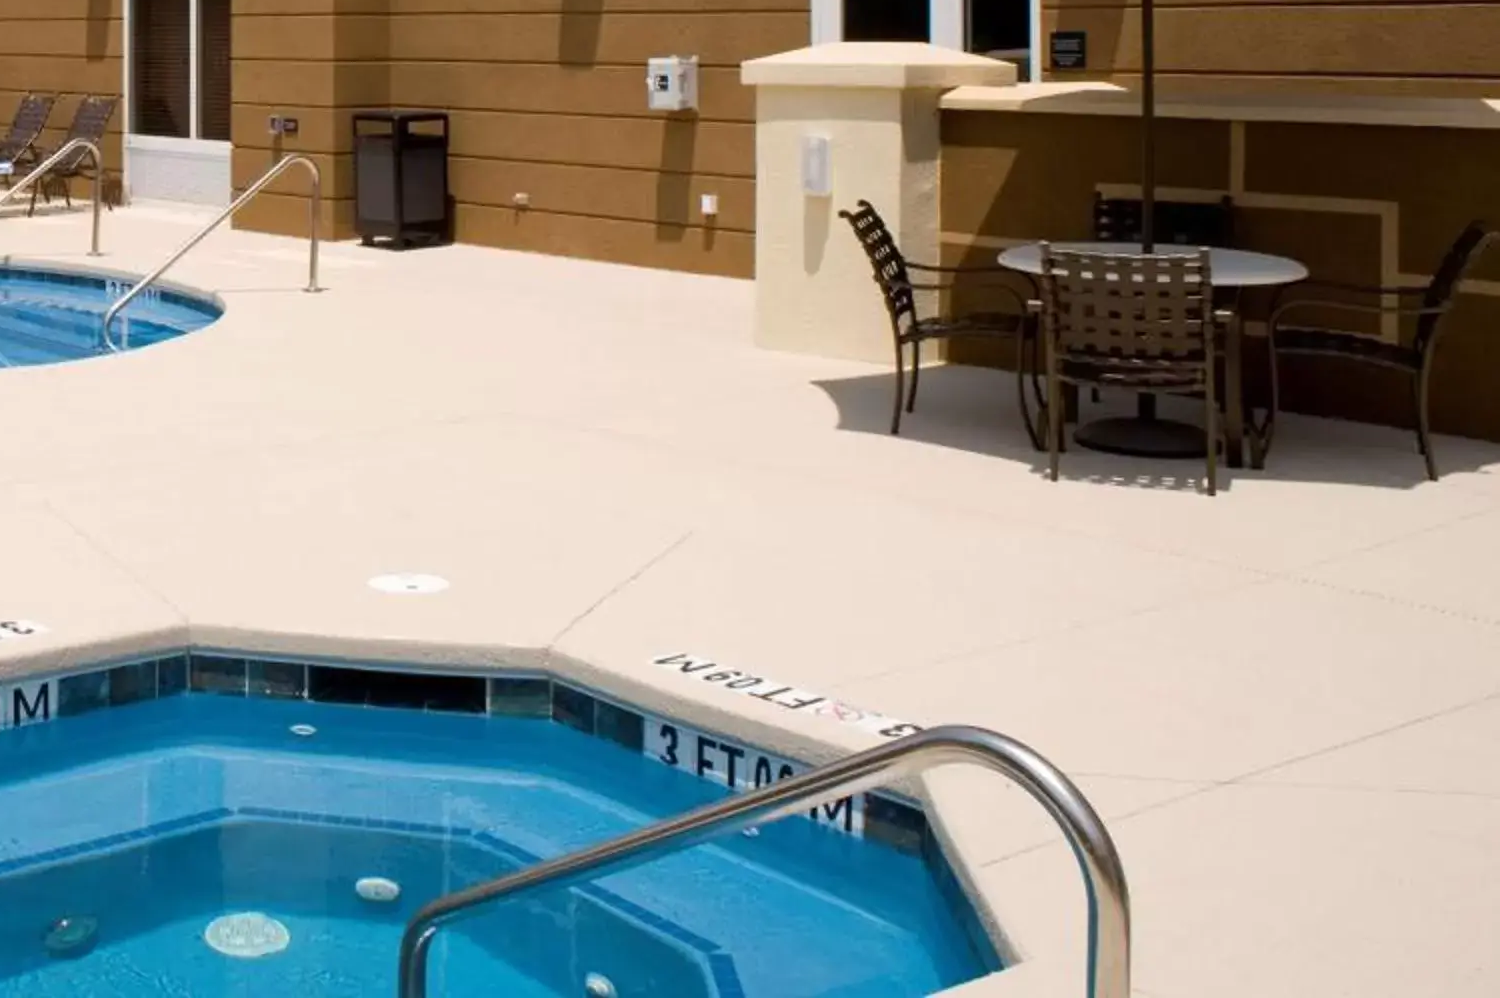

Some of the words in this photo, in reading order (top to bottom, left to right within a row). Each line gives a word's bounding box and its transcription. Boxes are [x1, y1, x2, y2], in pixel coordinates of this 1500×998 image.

[0, 620, 34, 636] 3
[654, 653, 717, 673] M
[13, 681, 50, 727] M
[747, 686, 826, 710] FT
[660, 724, 679, 767] 3
[697, 735, 745, 788] FT
